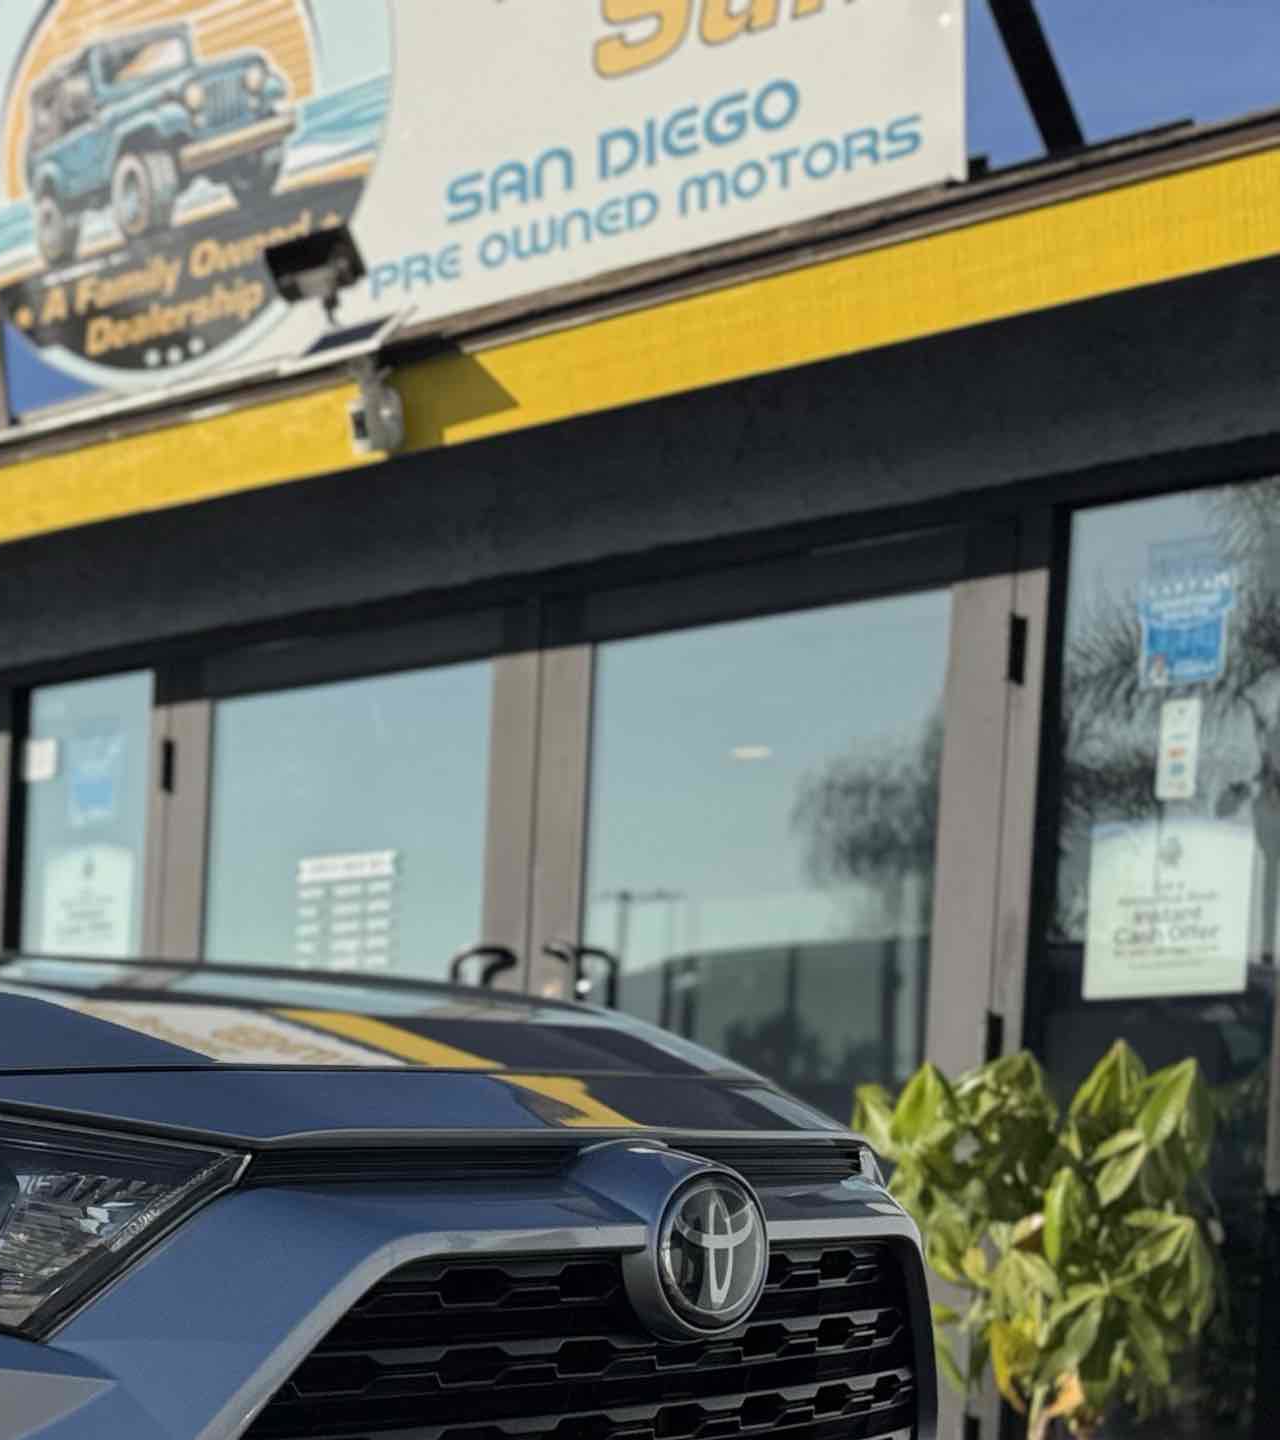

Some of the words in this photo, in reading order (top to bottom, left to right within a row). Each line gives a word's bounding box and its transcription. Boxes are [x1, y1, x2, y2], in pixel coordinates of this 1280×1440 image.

[369, 242, 463, 301] PRE
[478, 191, 660, 270] OWNED
[678, 113, 924, 218] MOTORS
[445, 146, 575, 225] SAN
[597, 78, 801, 182] DIEGO
[42, 286, 67, 321] A
[75, 254, 181, 314] Family
[85, 279, 264, 356] Dealership
